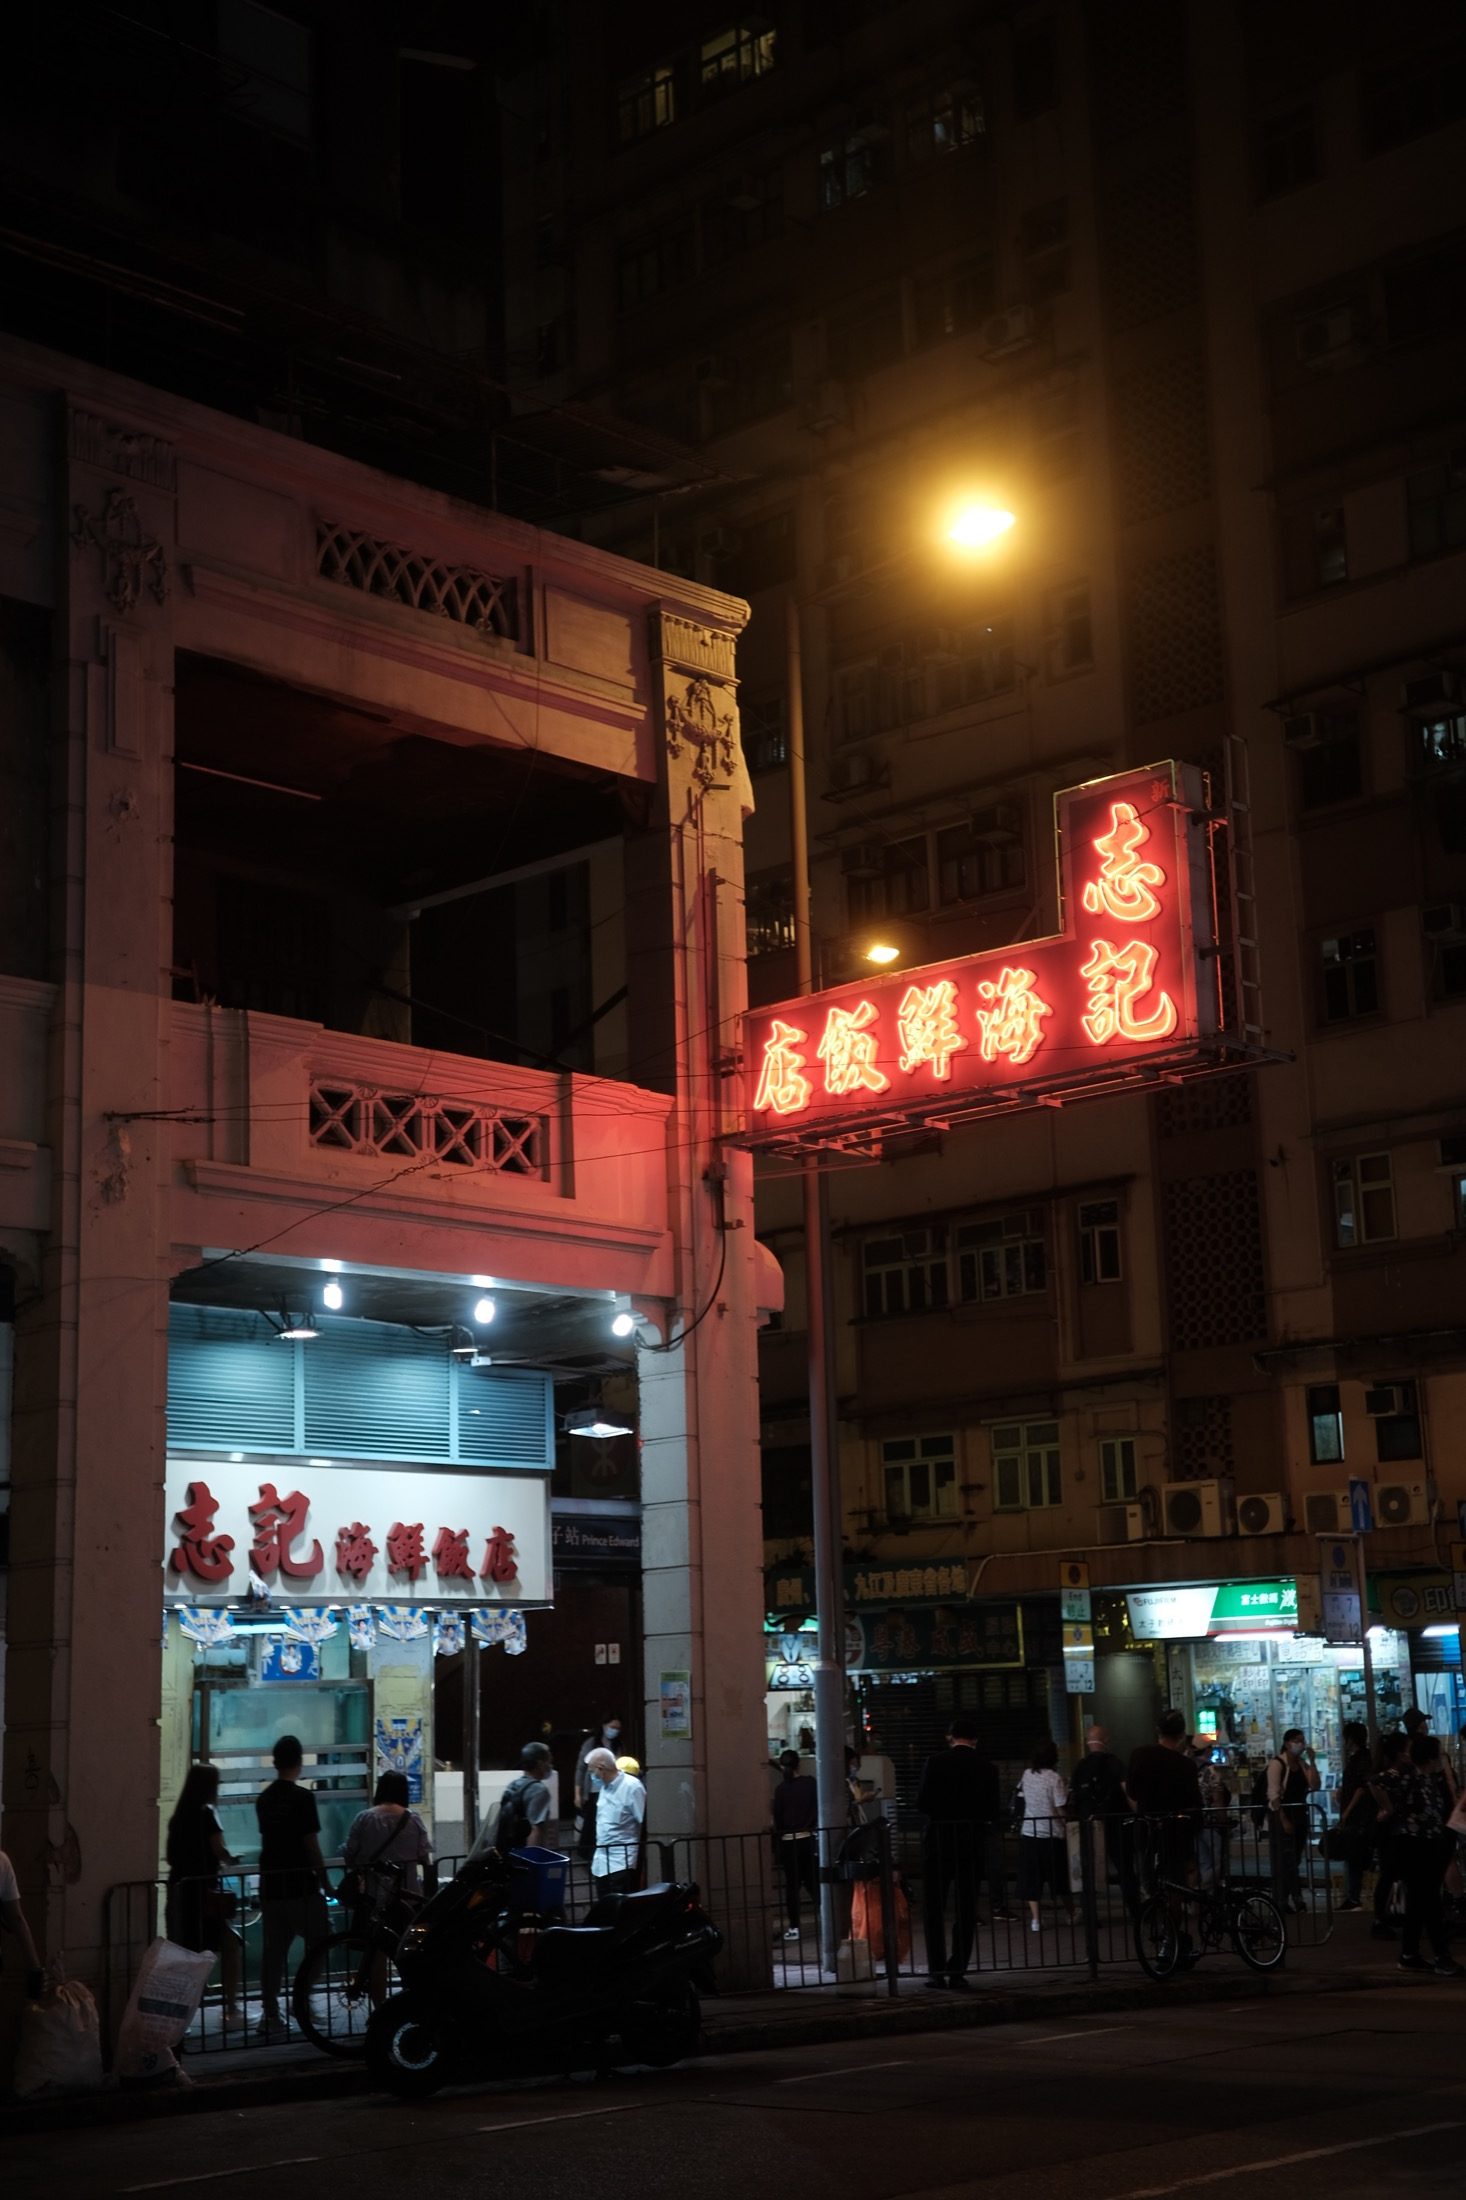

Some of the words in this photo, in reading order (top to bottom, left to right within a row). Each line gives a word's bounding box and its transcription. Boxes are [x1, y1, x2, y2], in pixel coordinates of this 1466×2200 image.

[1081, 801, 1178, 1044] 志記
[753, 966, 1052, 1114] 海鮮飯店
[582, 1534, 607, 1546] Prince
[608, 1535, 640, 1547] Edward
